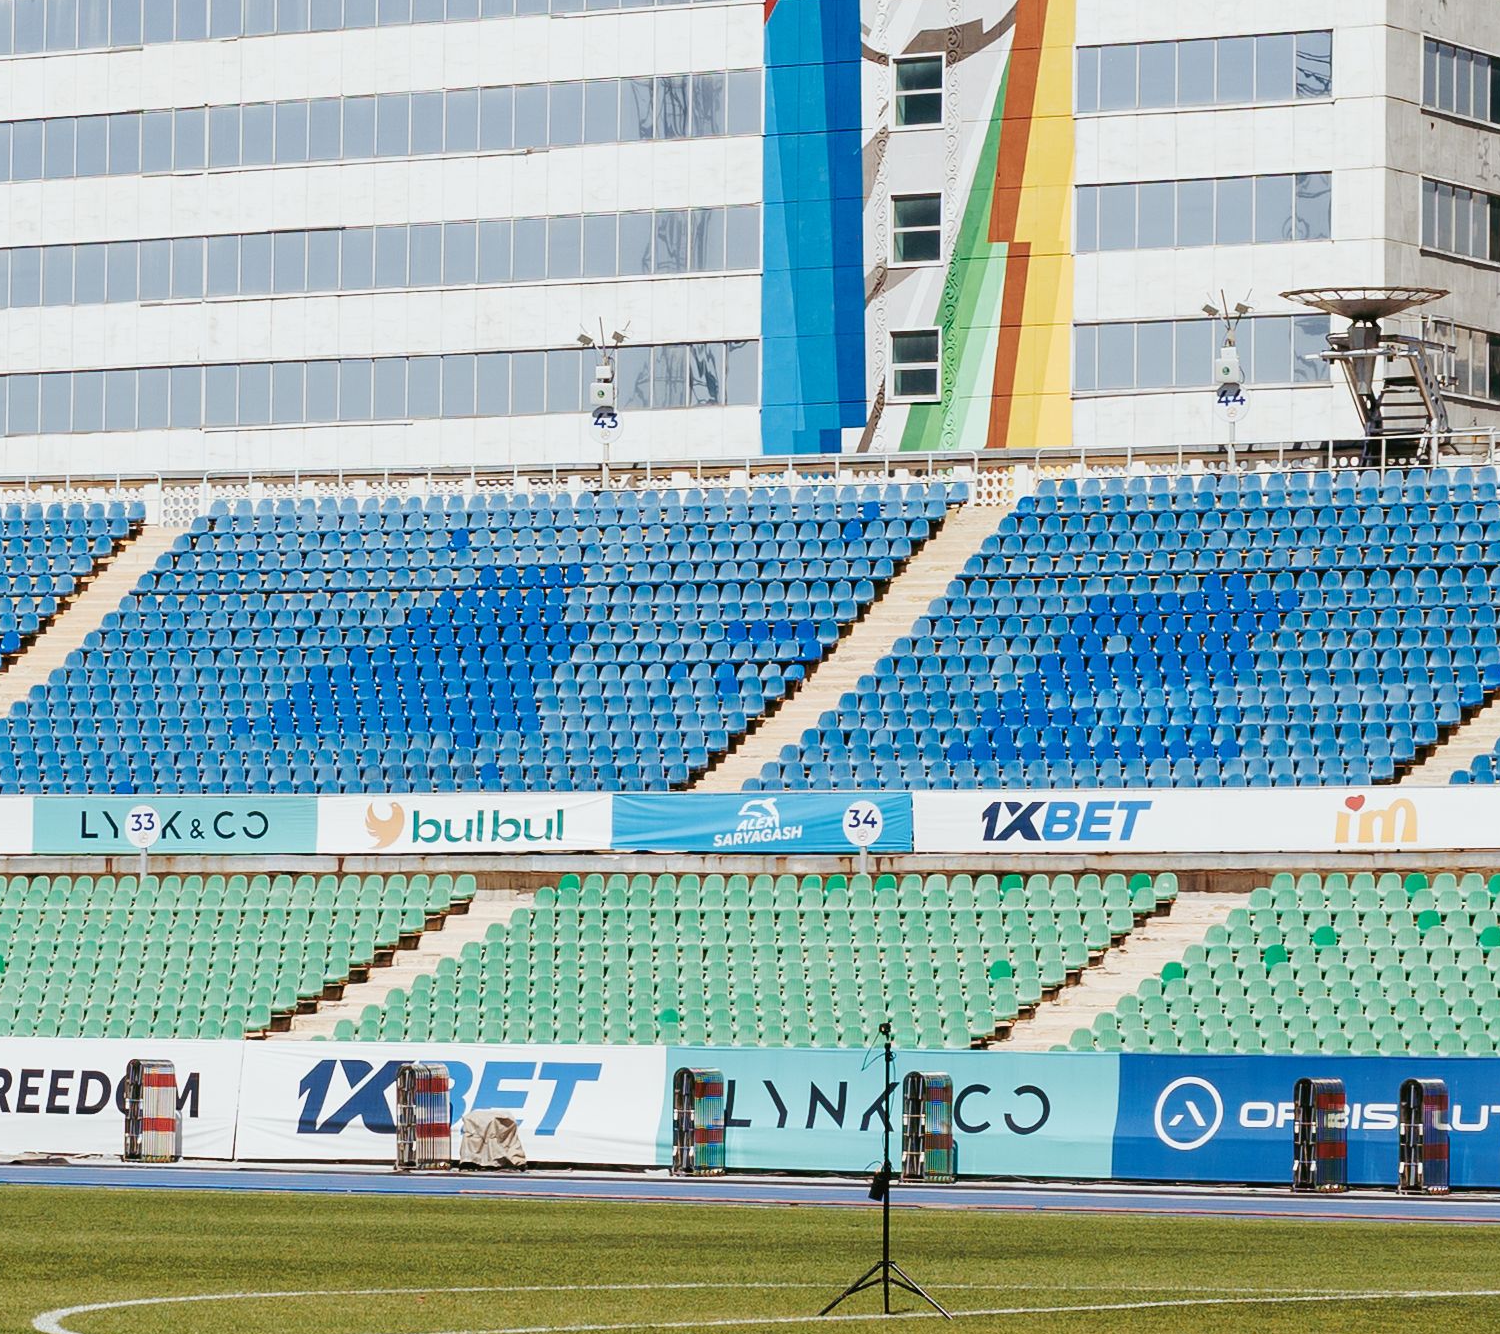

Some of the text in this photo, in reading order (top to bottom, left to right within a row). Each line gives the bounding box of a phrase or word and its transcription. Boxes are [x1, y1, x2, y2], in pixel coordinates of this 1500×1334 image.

[1217, 389, 1246, 407] 44
[593, 412, 618, 430] 43
[81, 810, 183, 839] LYK
[190, 818, 205, 840] &
[131, 812, 155, 832] 33
[412, 809, 564, 843] bulbul
[736, 816, 776, 832] ALEX
[848, 809, 878, 829] 34
[981, 800, 1153, 842] 1XBET
[712, 825, 803, 848] SARYAGASH
